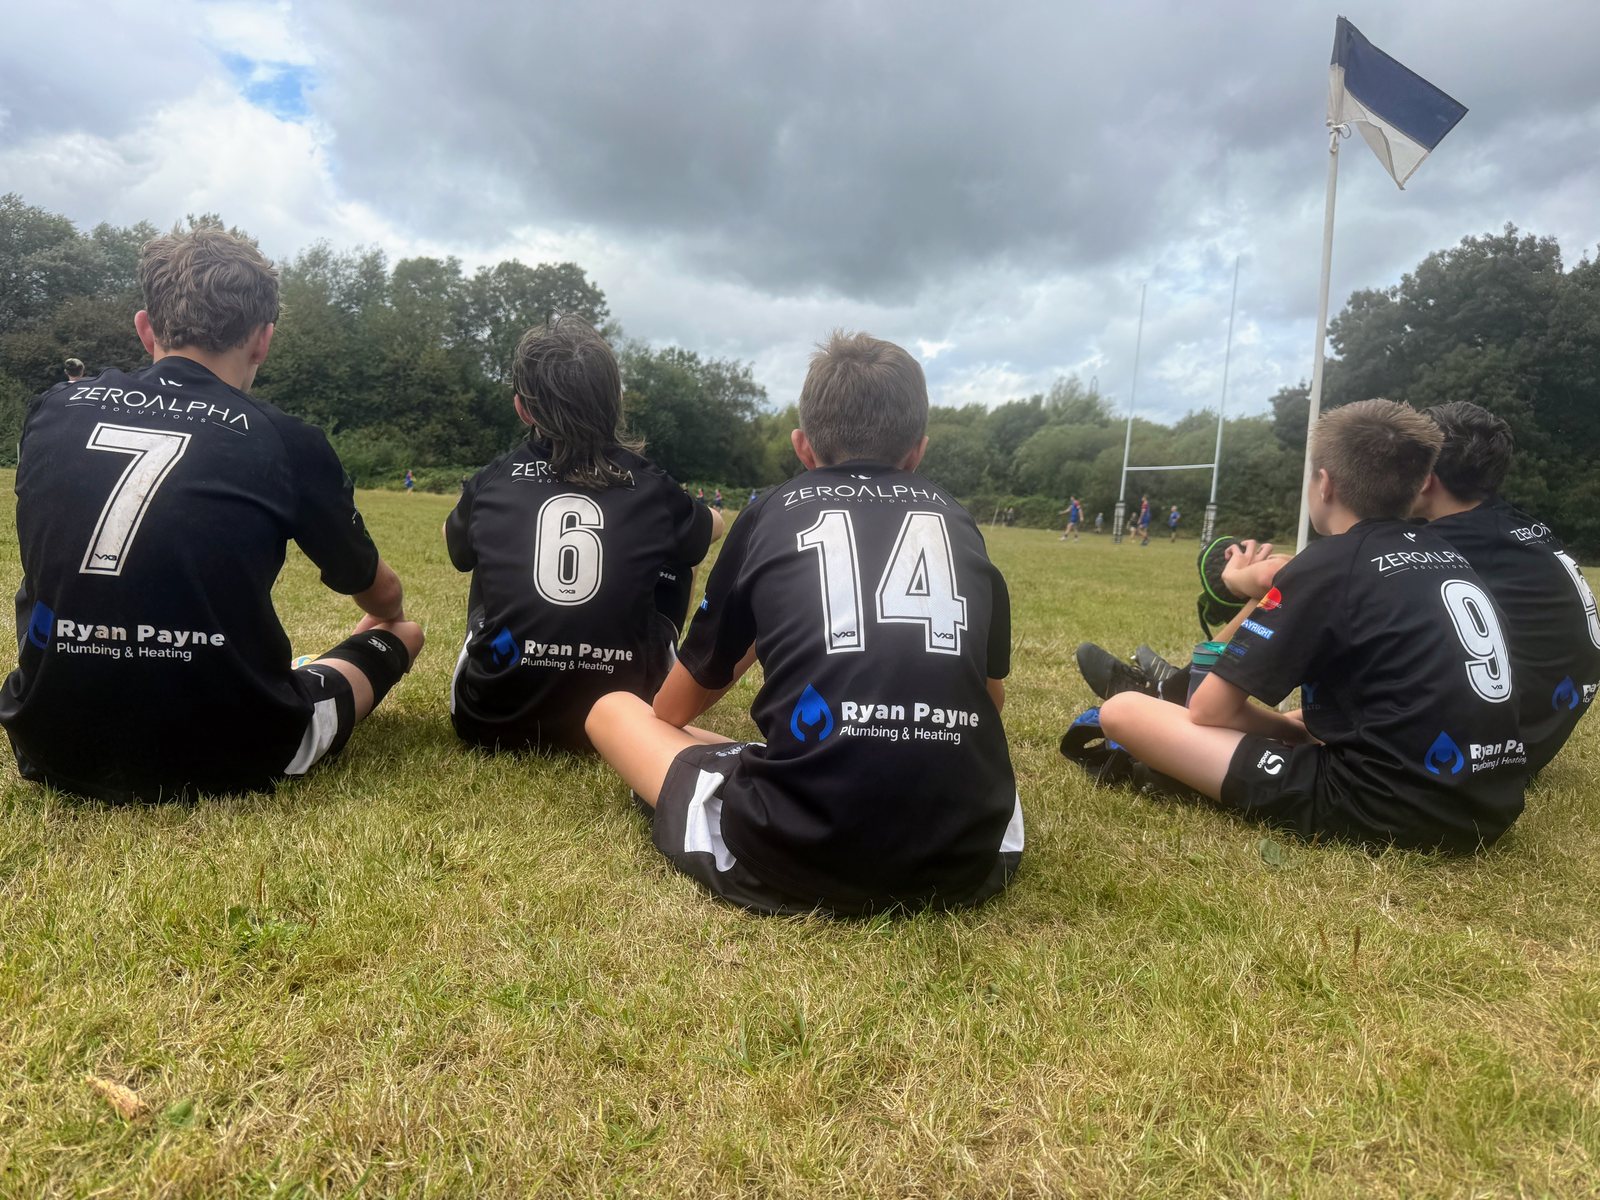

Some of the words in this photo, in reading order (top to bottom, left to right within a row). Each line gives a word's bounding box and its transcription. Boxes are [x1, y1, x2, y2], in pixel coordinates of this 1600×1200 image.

[69, 387, 249, 430] ZEROALPHA
[101, 405, 206, 423] SOLUTIONS
[79, 422, 192, 576] 7
[783, 485, 947, 506] ZEROALPHA
[533, 492, 604, 606] 6
[796, 510, 967, 656] 14
[56, 619, 127, 642] Ryan
[137, 624, 225, 647] Payne
[1440, 578, 1513, 704] 9
[56, 642, 120, 659] Plumbing
[124, 646, 134, 658] &
[138, 647, 192, 662] Heating
[524, 639, 573, 657] Ryan
[578, 643, 633, 662] Payne
[520, 657, 566, 671] Plumbing
[568, 660, 575, 670] &
[577, 660, 614, 674] Heating
[841, 701, 905, 723] Ryan
[913, 702, 979, 728] Payne
[840, 724, 898, 742] Plumbing
[901, 726, 910, 740] &
[914, 727, 961, 745] Heating
